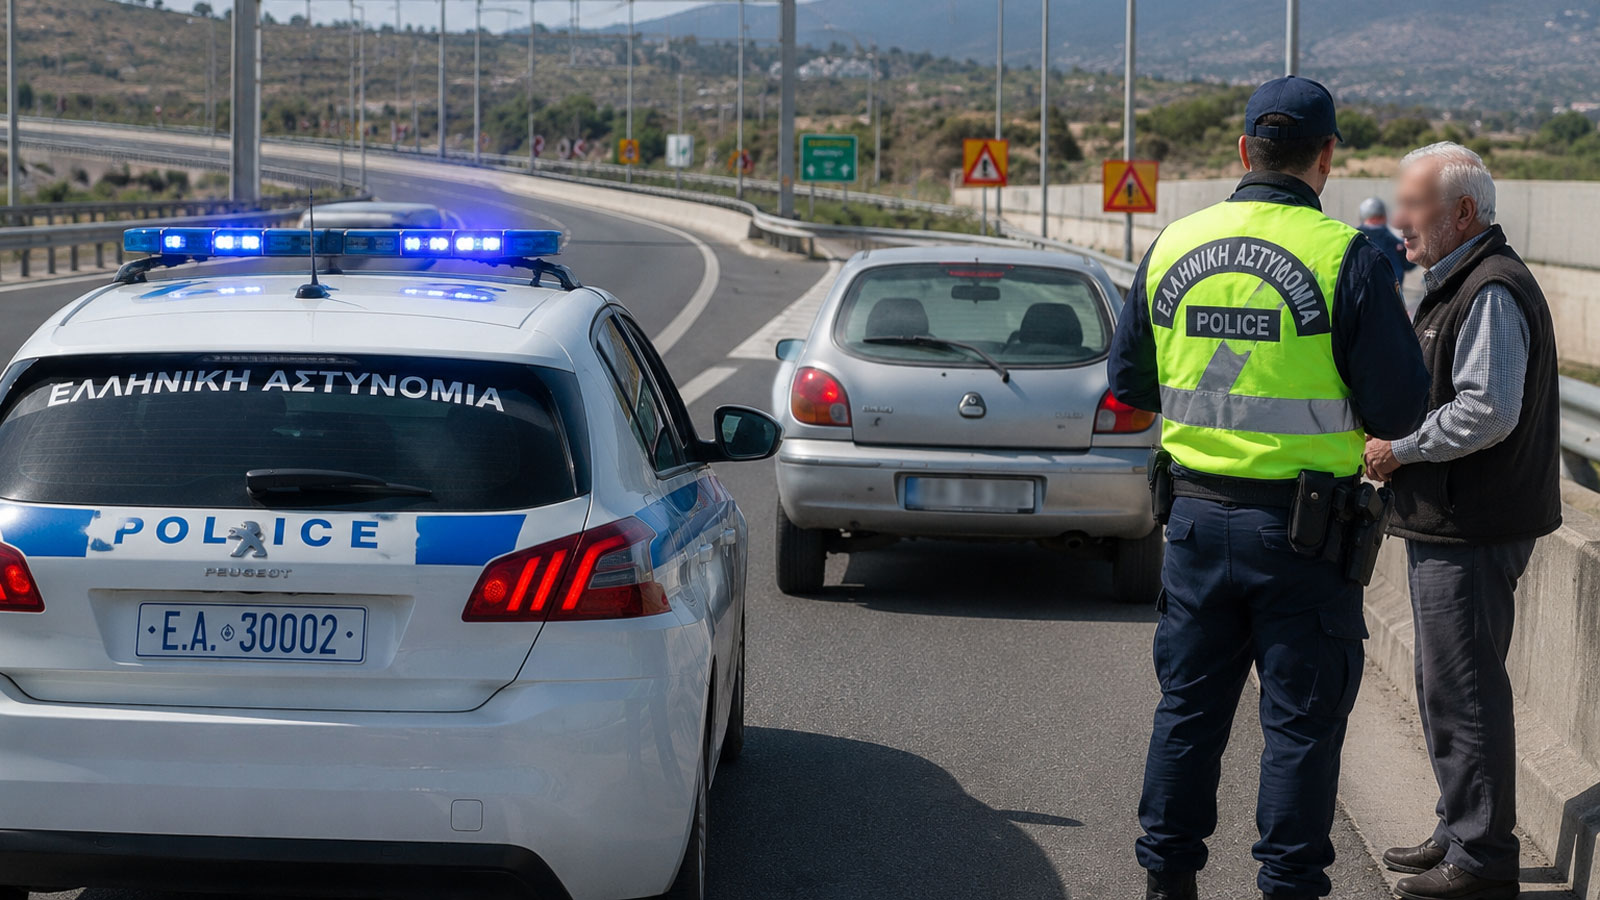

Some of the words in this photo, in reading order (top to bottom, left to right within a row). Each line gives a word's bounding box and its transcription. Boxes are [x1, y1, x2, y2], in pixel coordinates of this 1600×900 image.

[1156, 244, 1230, 318] ΕΛΛΗΝΙΚΗ
[1196, 312, 1270, 336] POLICE
[47, 369, 252, 407] ΕΛΛΗΝΙΚΗ
[262, 369, 505, 412] ΑΣΤΥΝΟΜΙΑ
[204, 567, 293, 579] PEUGEOT
[239, 612, 338, 655] 30002
